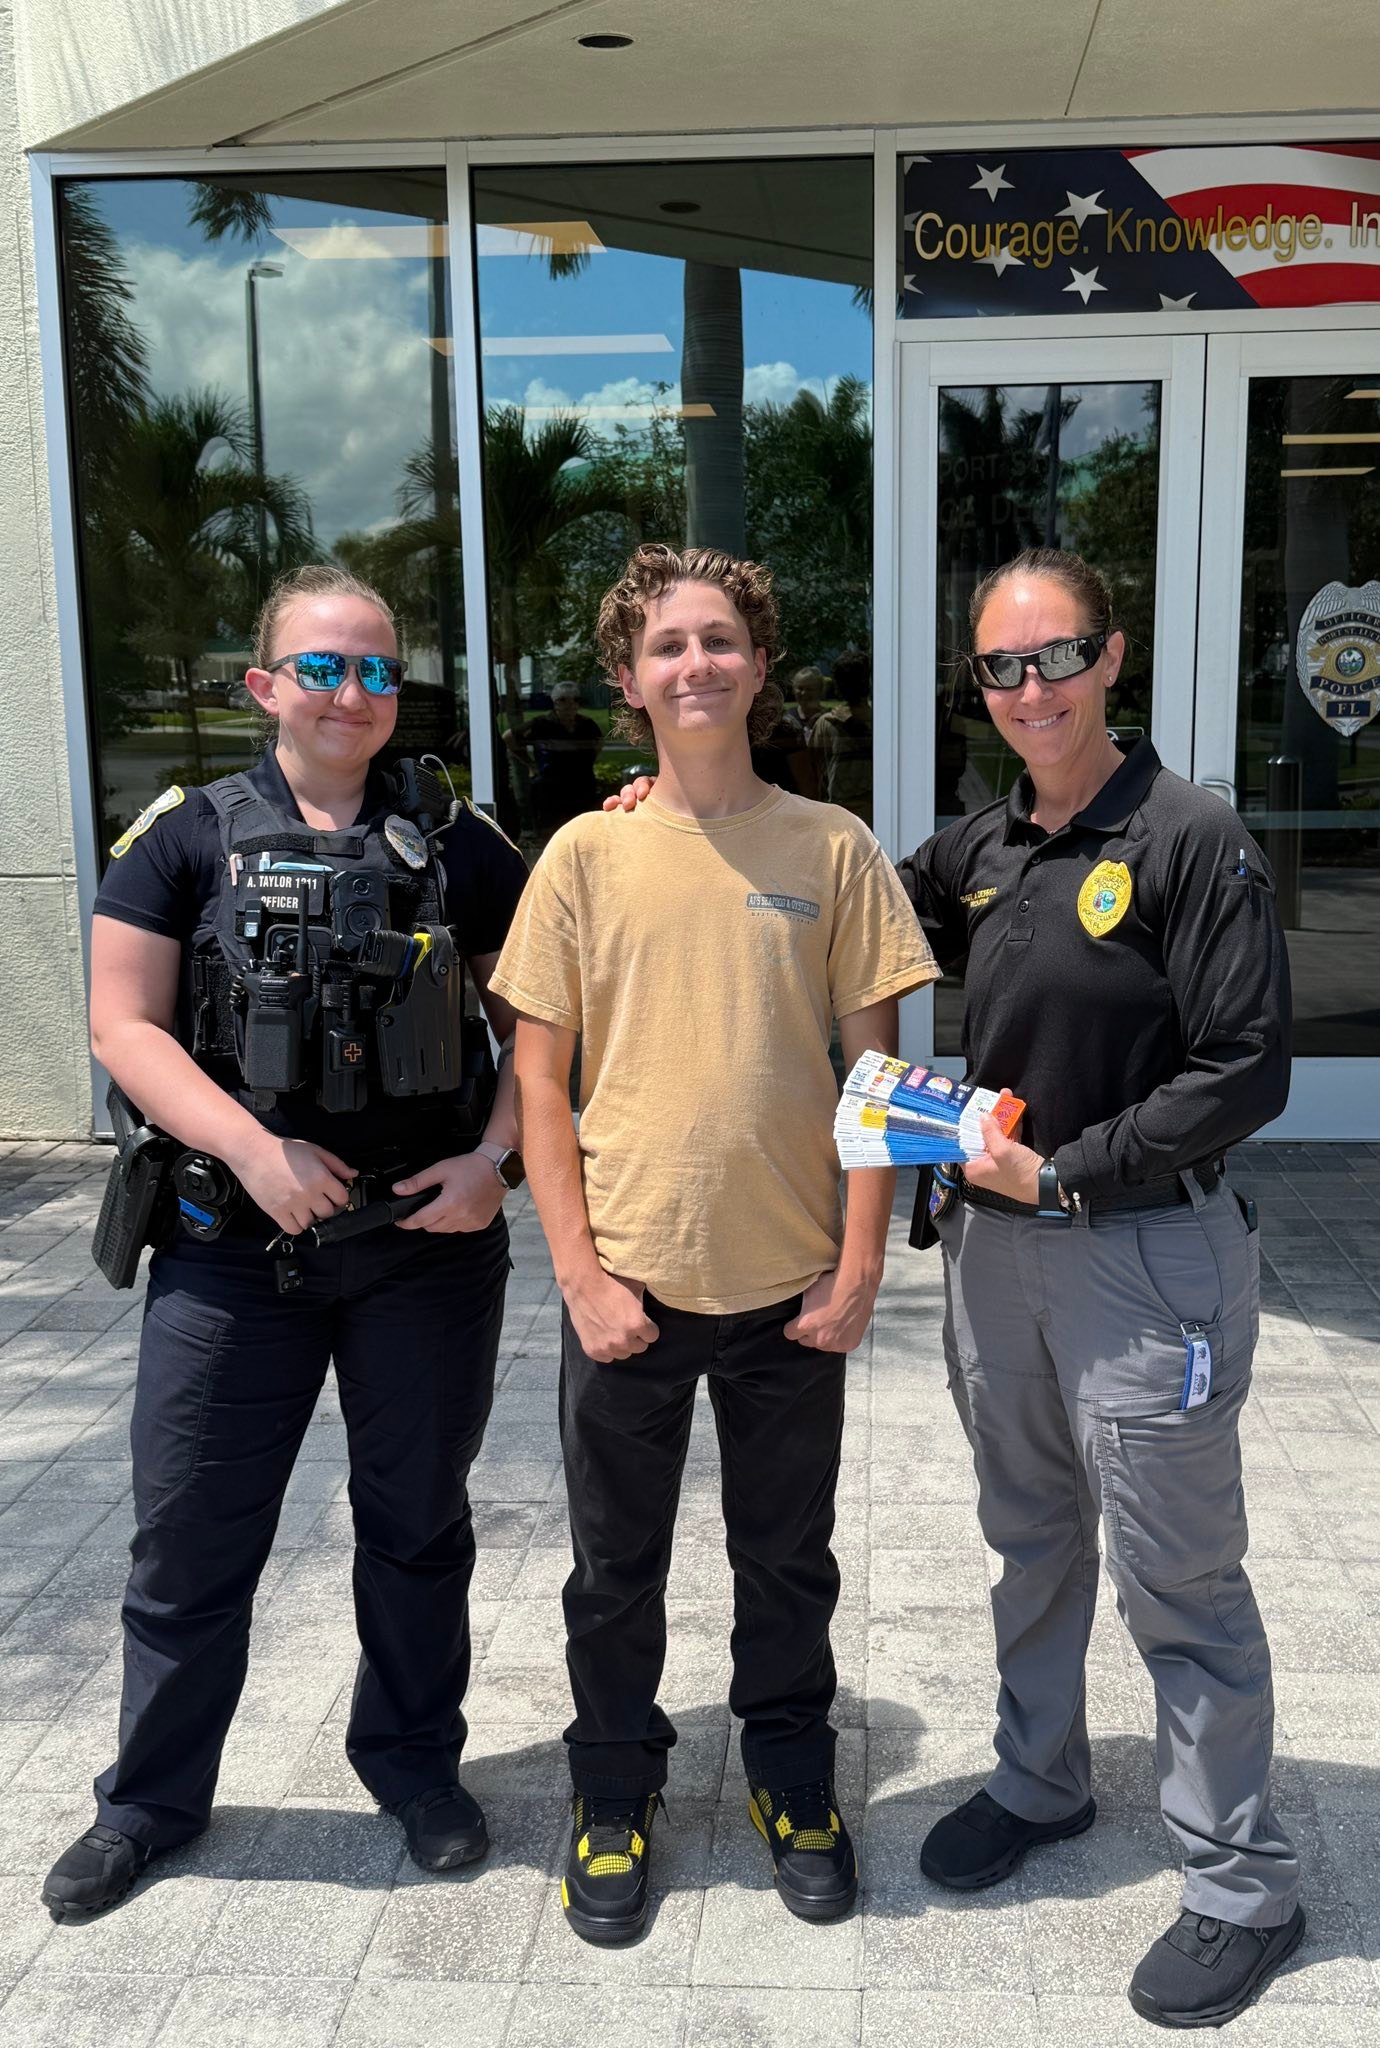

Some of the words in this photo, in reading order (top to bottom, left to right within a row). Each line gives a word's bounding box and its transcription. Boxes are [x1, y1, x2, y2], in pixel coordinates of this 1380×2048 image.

[915, 212, 1089, 269] Courage.
[1106, 203, 1333, 262] Knowledge.
[1319, 676, 1380, 696] POLICE
[1337, 702, 1360, 716] FL
[247, 876, 256, 888] A.
[259, 875, 292, 888] TAYLOR
